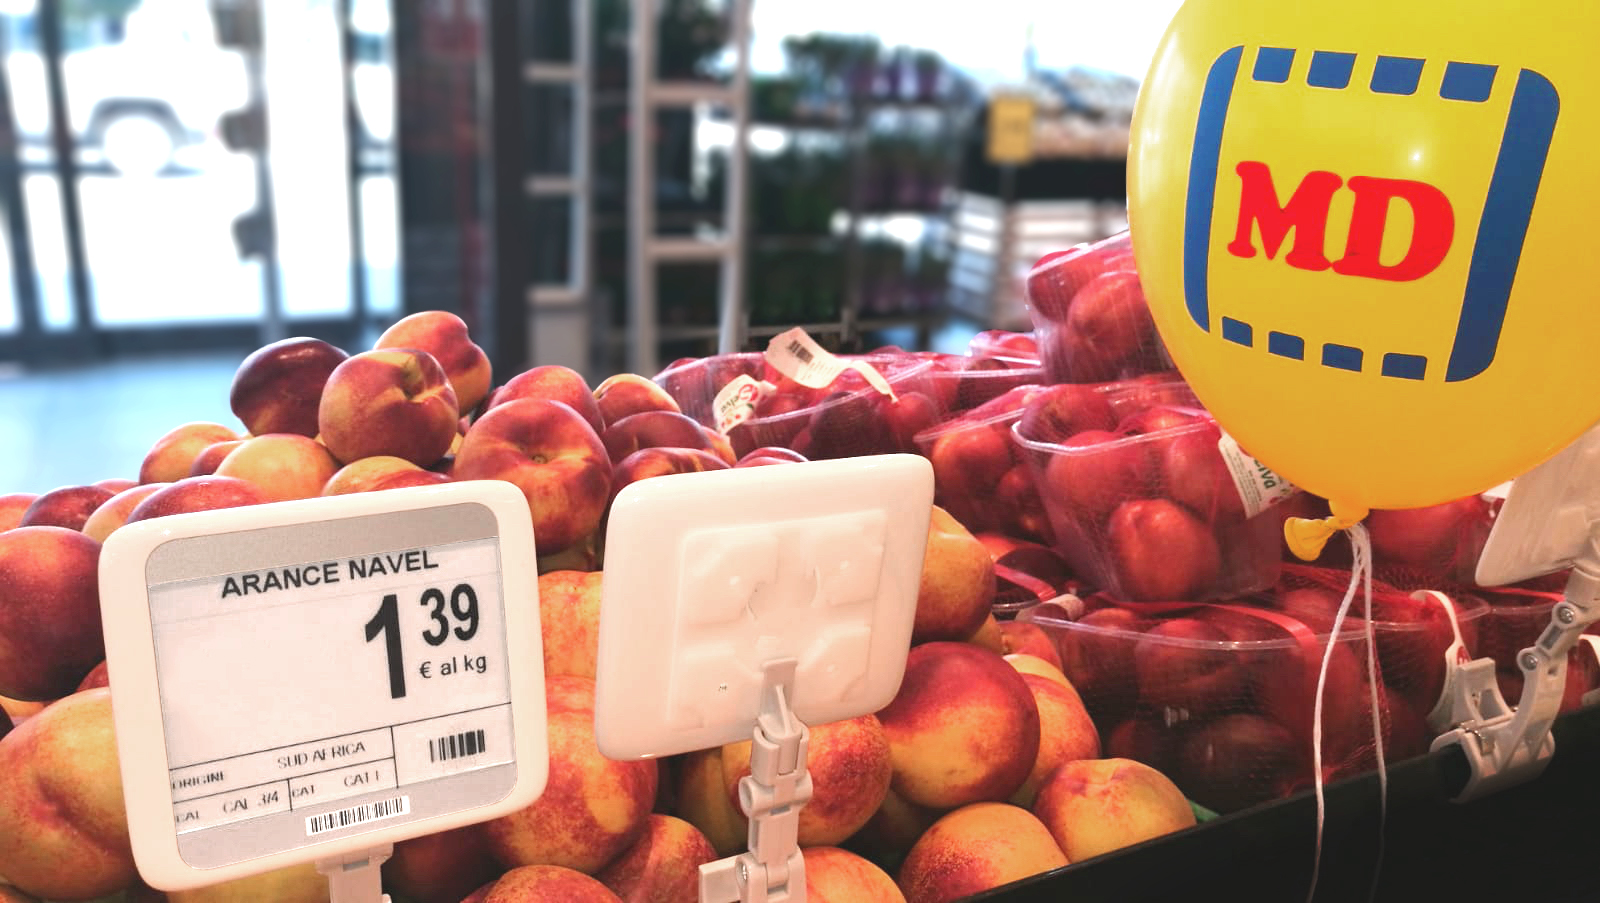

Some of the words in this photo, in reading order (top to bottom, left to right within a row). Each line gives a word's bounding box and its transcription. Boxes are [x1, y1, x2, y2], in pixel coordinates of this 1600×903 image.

[1227, 160, 1455, 282] MD
[222, 563, 340, 599] ARANCE
[349, 549, 439, 581] NAVEL
[365, 593, 406, 699] 1
[420, 583, 479, 646] 39
[419, 660, 433, 679] €
[440, 656, 458, 675] al
[464, 654, 488, 674] kg
[278, 752, 309, 769] SUD
